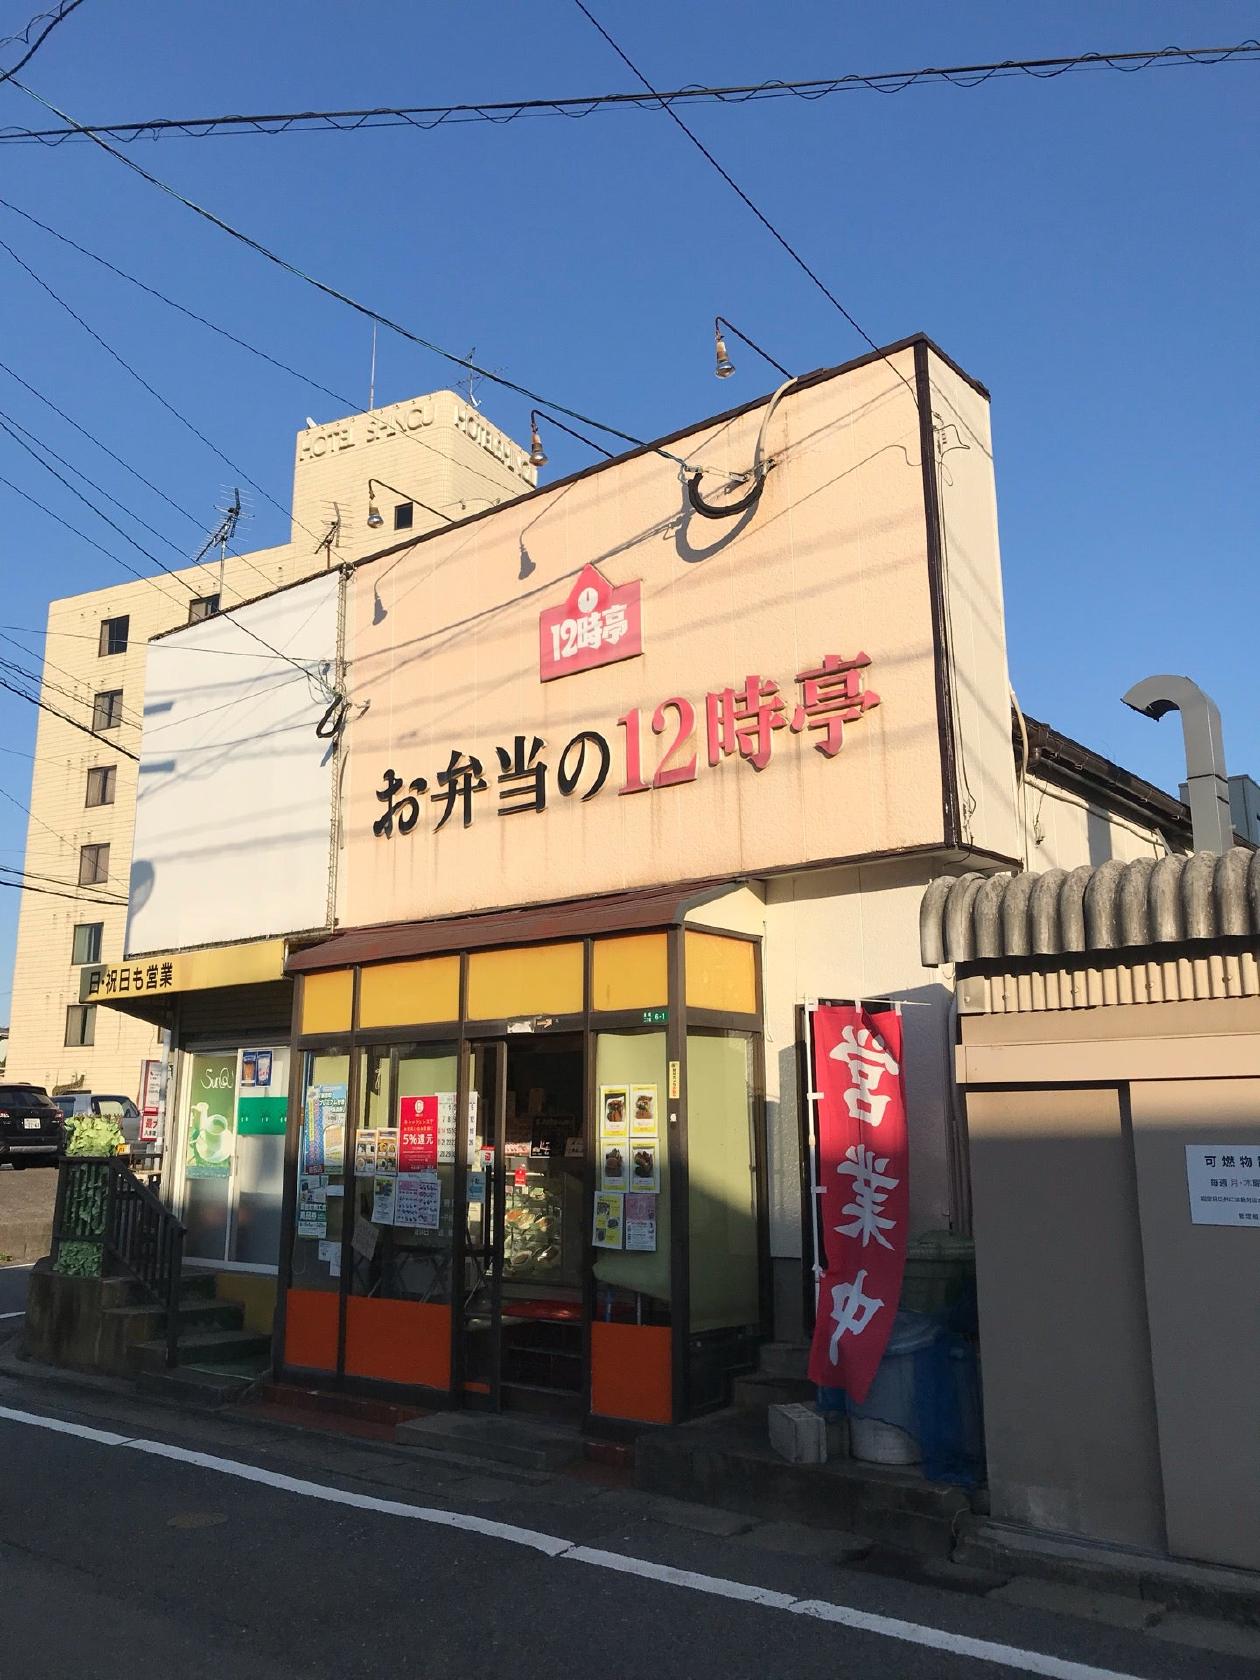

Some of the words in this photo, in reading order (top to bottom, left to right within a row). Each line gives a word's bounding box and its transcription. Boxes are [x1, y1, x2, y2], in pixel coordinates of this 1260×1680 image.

[550, 602, 629, 662] 12時亭
[373, 651, 882, 839] お弁当の12時亭
[88, 962, 173, 995] 日・祝日も営業
[402, 1133, 433, 1145] 5%還元
[1204, 1155, 1260, 1168] 可燃物
[828, 1023, 900, 1367] 営業中
